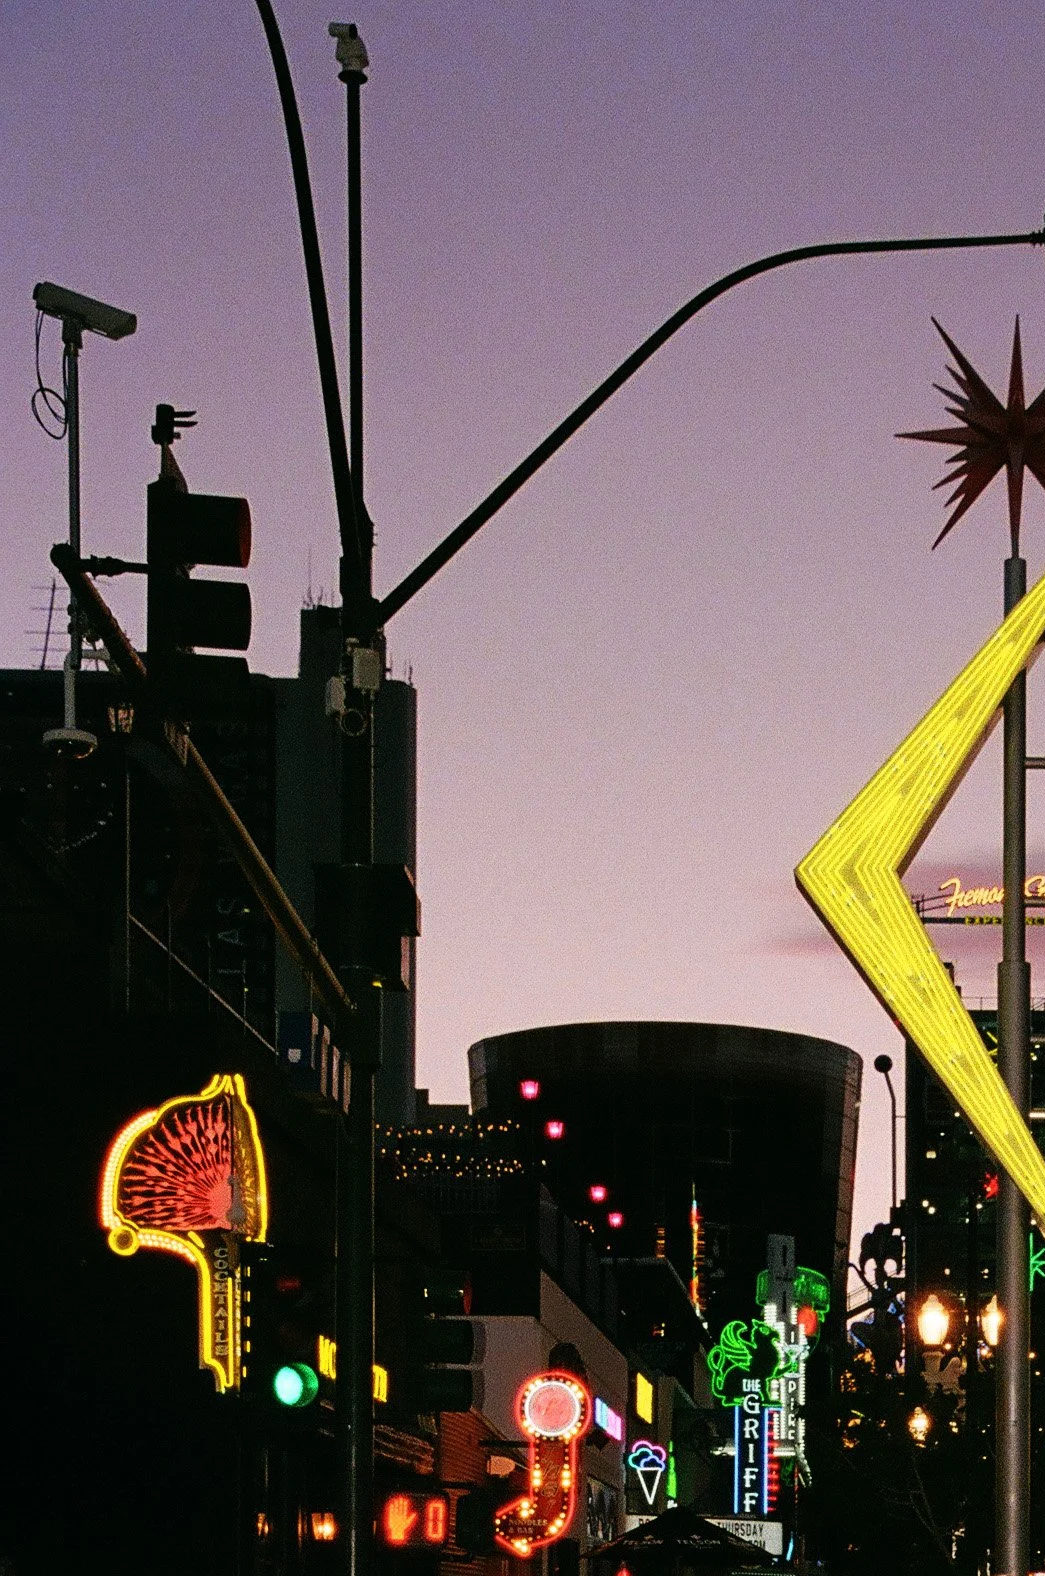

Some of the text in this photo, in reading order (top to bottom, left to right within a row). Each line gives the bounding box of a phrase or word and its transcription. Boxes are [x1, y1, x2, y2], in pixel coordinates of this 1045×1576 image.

[939, 877, 1004, 917] Fremo
[213, 1248, 229, 1356] COCKTAILS
[742, 1378, 761, 1392] THE
[743, 1393, 760, 1513] GRIFF
[717, 1522, 764, 1537] URSDAY
